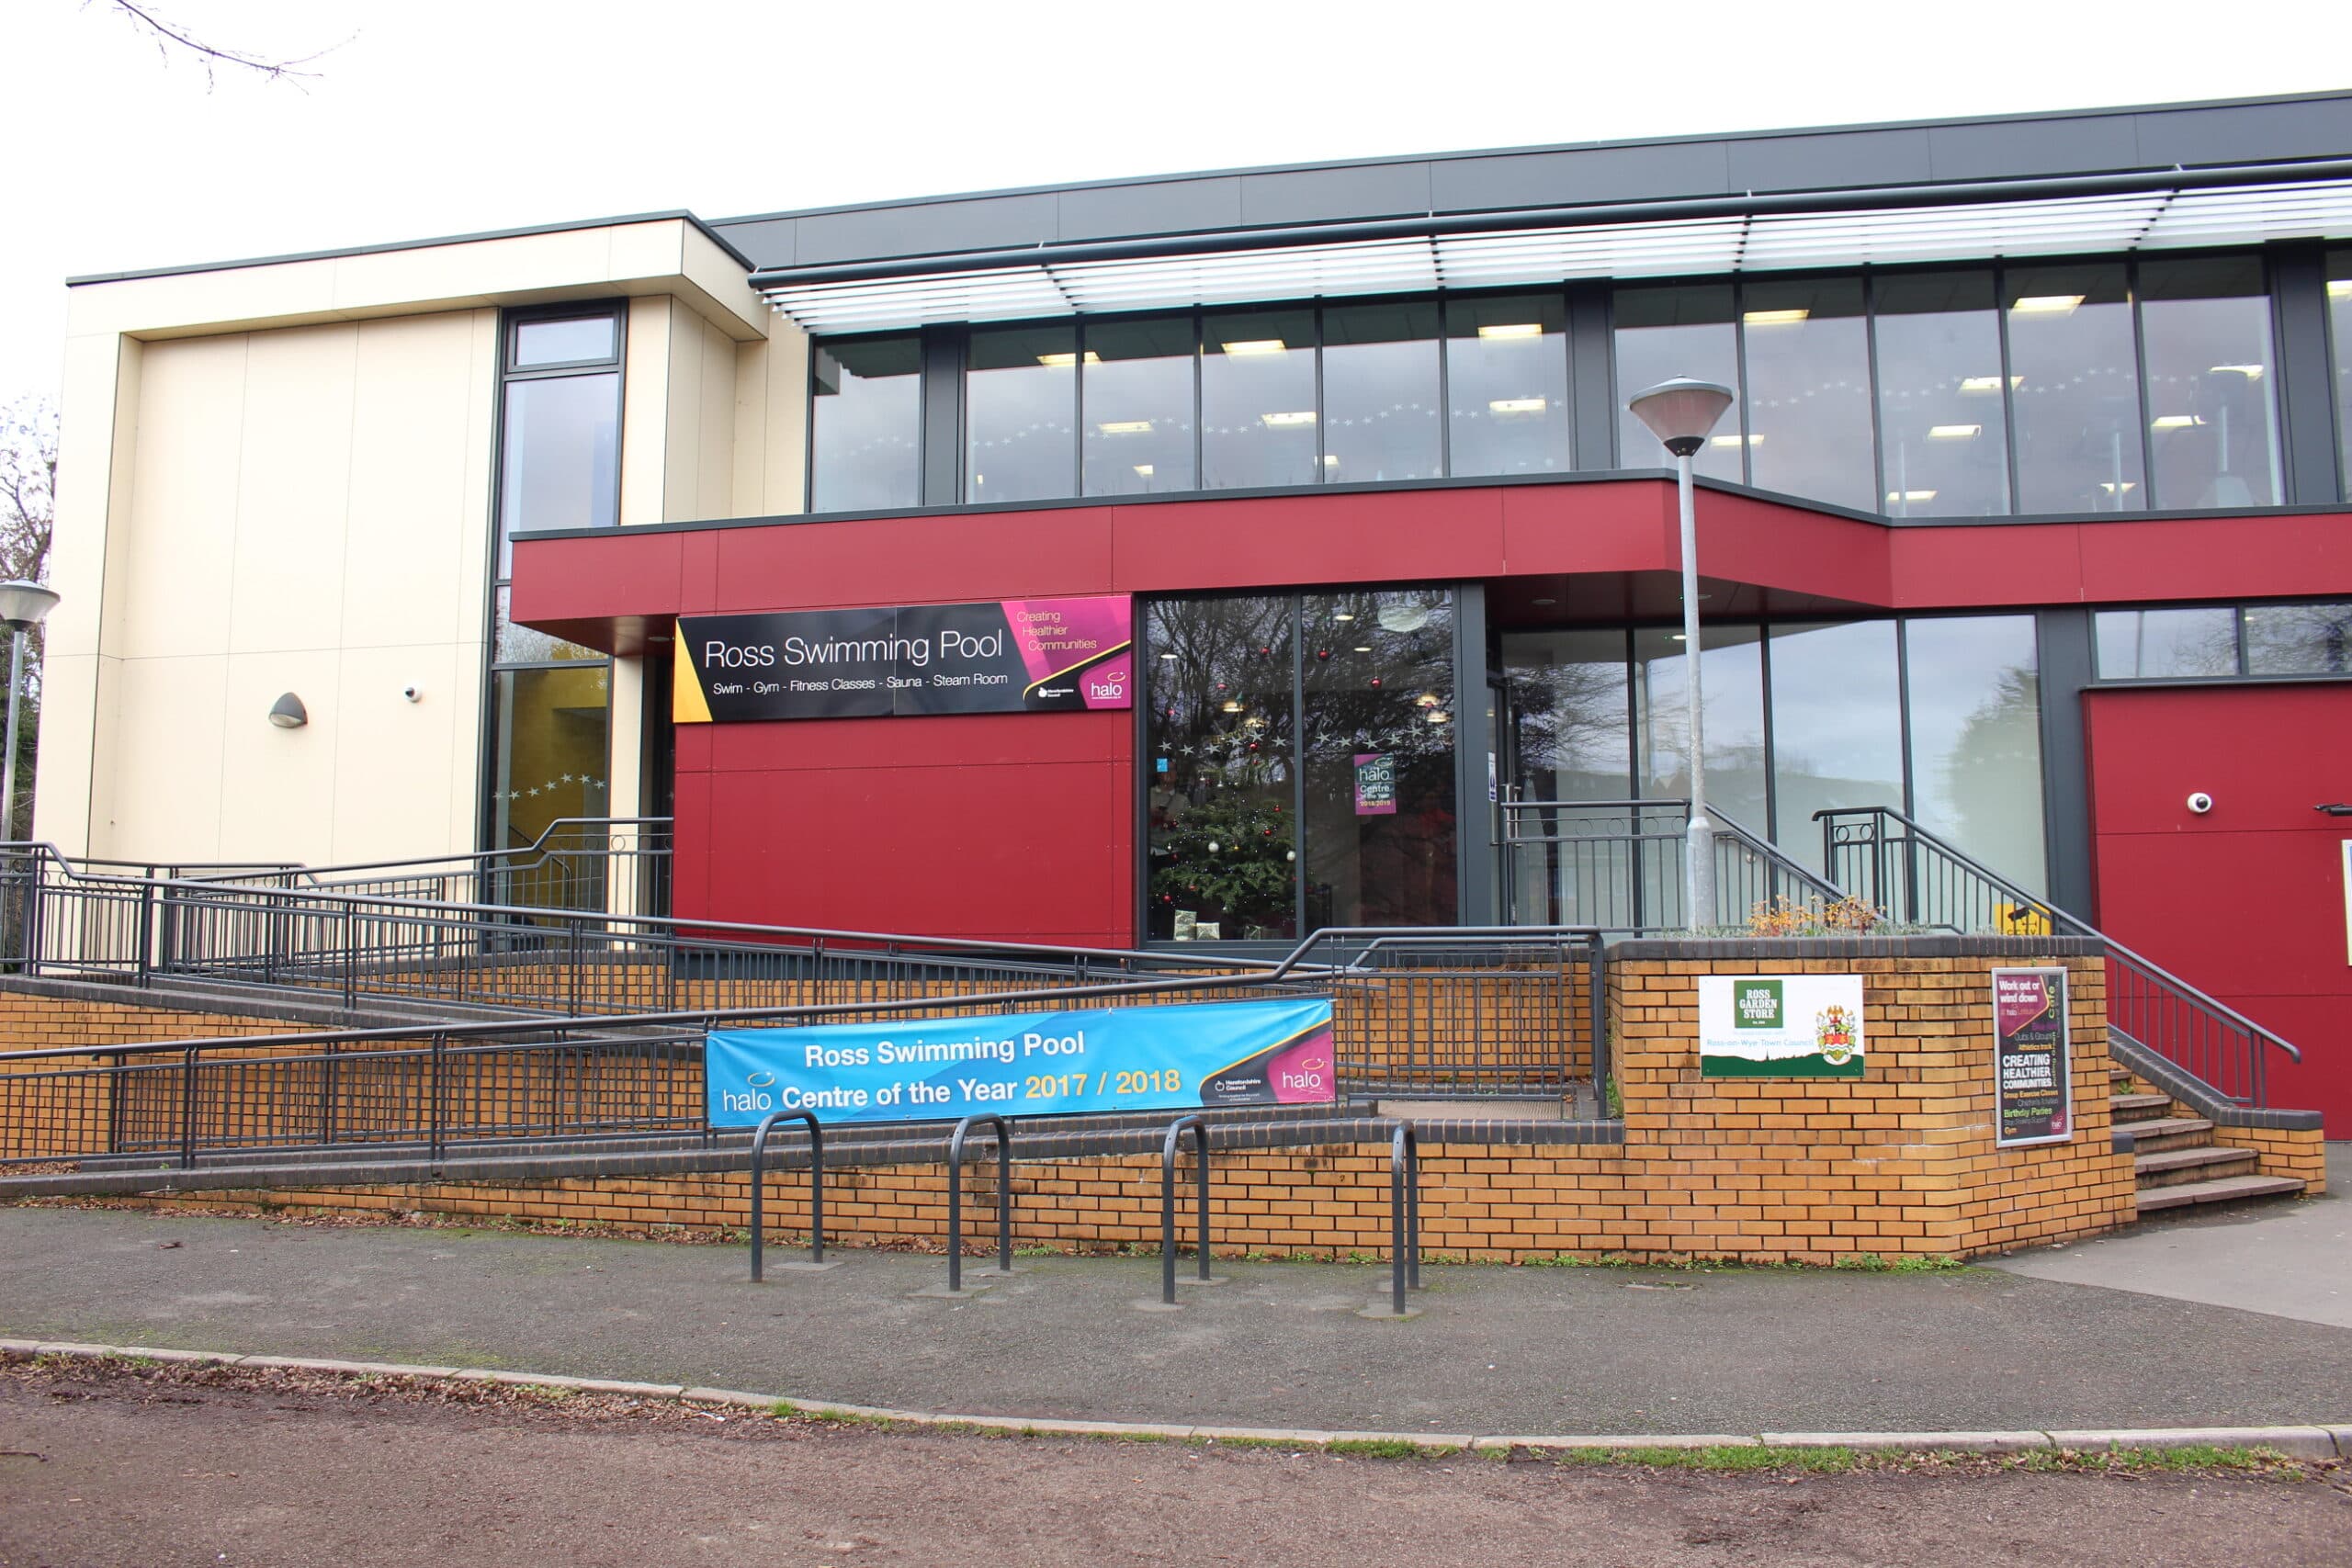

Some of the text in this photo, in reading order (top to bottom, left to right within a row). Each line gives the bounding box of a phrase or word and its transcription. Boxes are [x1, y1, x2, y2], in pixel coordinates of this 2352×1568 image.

[1016, 610, 1061, 624] Creating
[1022, 626, 1069, 637] Healthier
[705, 628, 1002, 669] Ross Swimming Pool
[1028, 639, 1097, 651] Communities
[713, 682, 743, 695] Swim
[753, 681, 780, 695] Gym
[790, 680, 829, 692] Fitness
[831, 677, 876, 690] Classes
[887, 675, 922, 689] Sauna
[933, 674, 971, 687] Steam
[973, 672, 1008, 685] Room
[1091, 682, 1123, 696] halo
[1359, 767, 1390, 782] halo
[1360, 784, 1390, 794] Centre
[1998, 981, 2040, 990] Work out or
[1746, 989, 1770, 999] ROSS
[1739, 998, 1778, 1009] GARDEN
[1743, 1009, 1775, 1019] STORE
[805, 1030, 1085, 1067] Ross Swimming Pool
[2002, 1055, 2051, 1067] CREATING
[2003, 1067, 2052, 1079] HEALTHIER
[1282, 1070, 1321, 1089] halo
[2003, 1078, 2052, 1089] COMMUNITIES
[782, 1086, 868, 1110] Centre
[876, 1082, 902, 1105] of
[909, 1080, 951, 1103] the
[957, 1077, 1018, 1101] Year
[1025, 1073, 1088, 1099] 2017
[1115, 1068, 1182, 1094] 2018
[723, 1088, 772, 1111] halo
